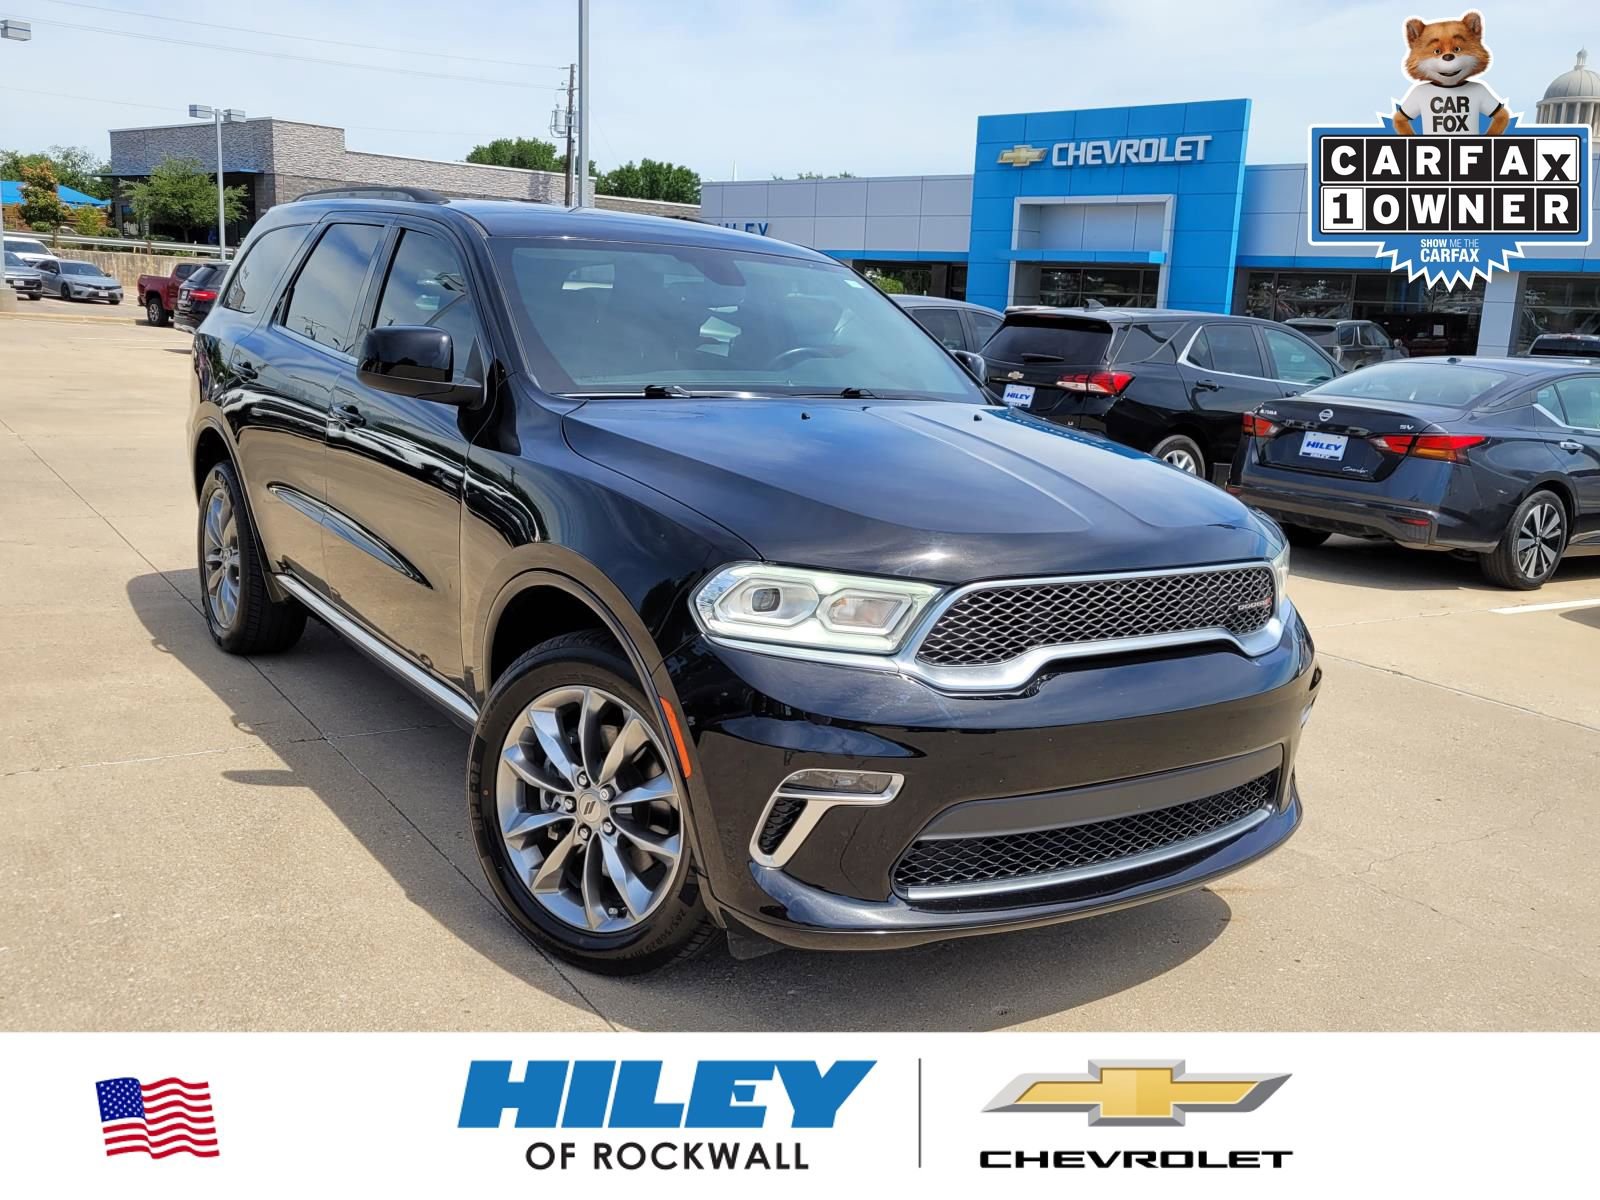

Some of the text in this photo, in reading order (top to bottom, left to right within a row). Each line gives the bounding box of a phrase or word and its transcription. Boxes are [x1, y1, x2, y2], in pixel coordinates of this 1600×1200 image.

[1051, 135, 1213, 167] CHEVROLET
[1006, 392, 1031, 400] HILEY
[1306, 440, 1343, 451] HILEY
